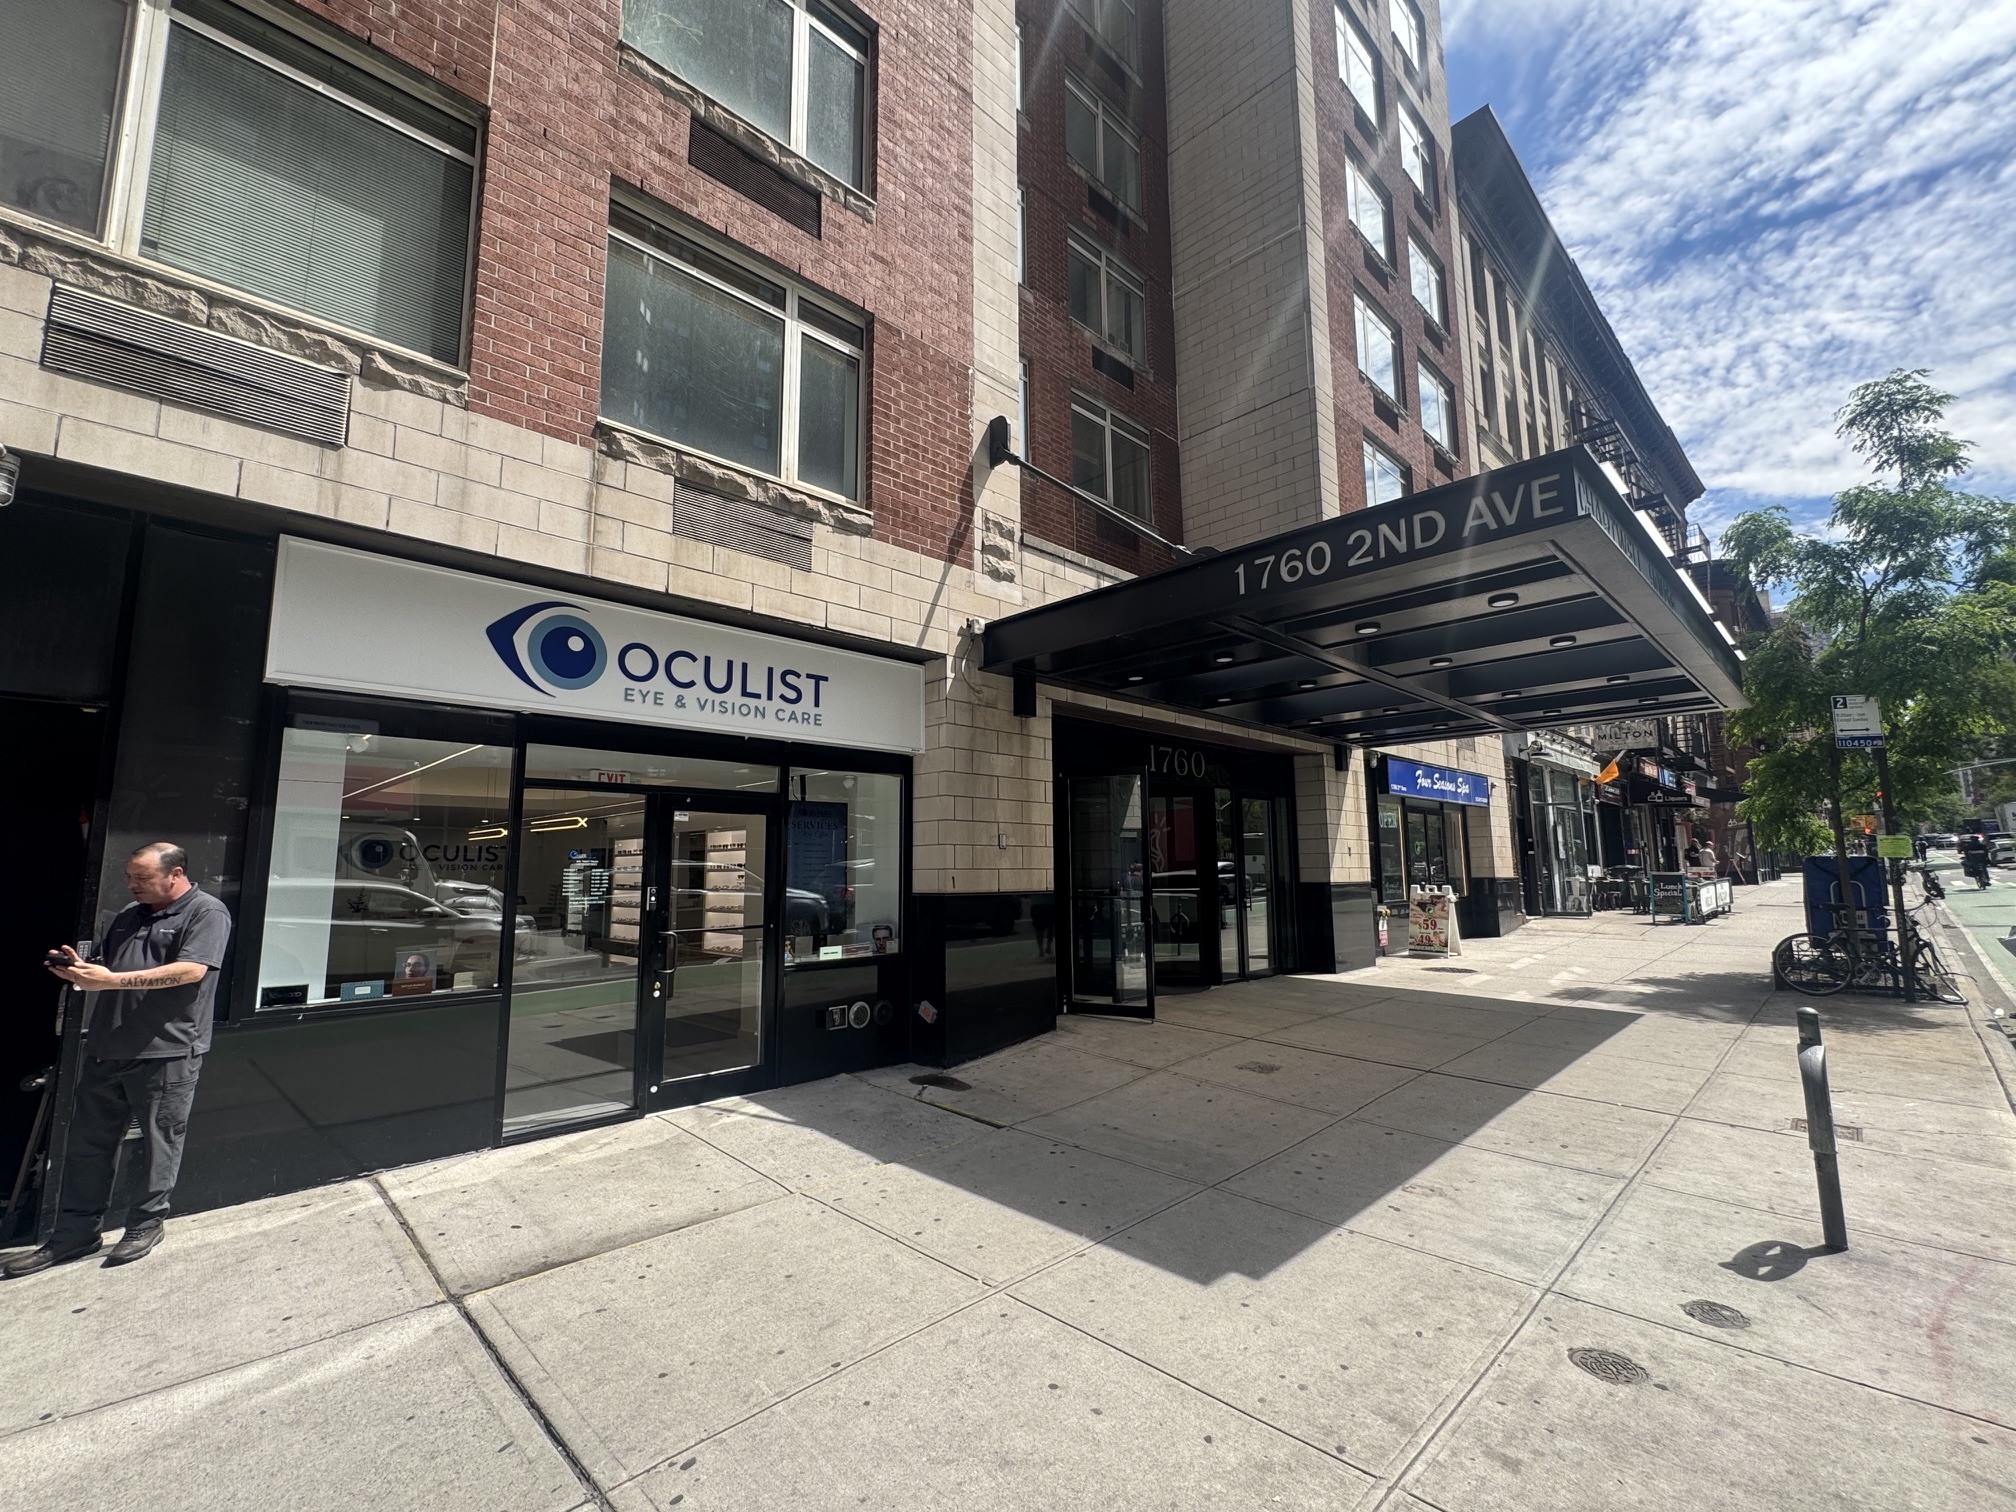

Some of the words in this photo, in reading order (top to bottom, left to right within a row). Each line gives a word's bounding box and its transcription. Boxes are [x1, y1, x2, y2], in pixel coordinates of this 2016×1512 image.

[1234, 541, 1332, 595] 1760
[1346, 509, 1447, 567] 2ND
[1461, 473, 1565, 538] AVE
[617, 641, 830, 708] OCULIST
[623, 687, 665, 706] EYE
[674, 694, 687, 709] &
[696, 696, 767, 720] VISION
[775, 708, 823, 727] CARE
[1835, 697, 1845, 709] 2
[1597, 730, 1653, 741] MILTON
[1838, 739, 1872, 748] 110450
[1149, 744, 1206, 778] 1760
[1415, 769, 1432, 790] Four
[1433, 773, 1456, 792] Seasons
[1457, 777, 1470, 796] Spa
[791, 819, 839, 831] SERVICES
[1379, 812, 1398, 828] OPEN
[120, 976, 182, 988] SALVATION
